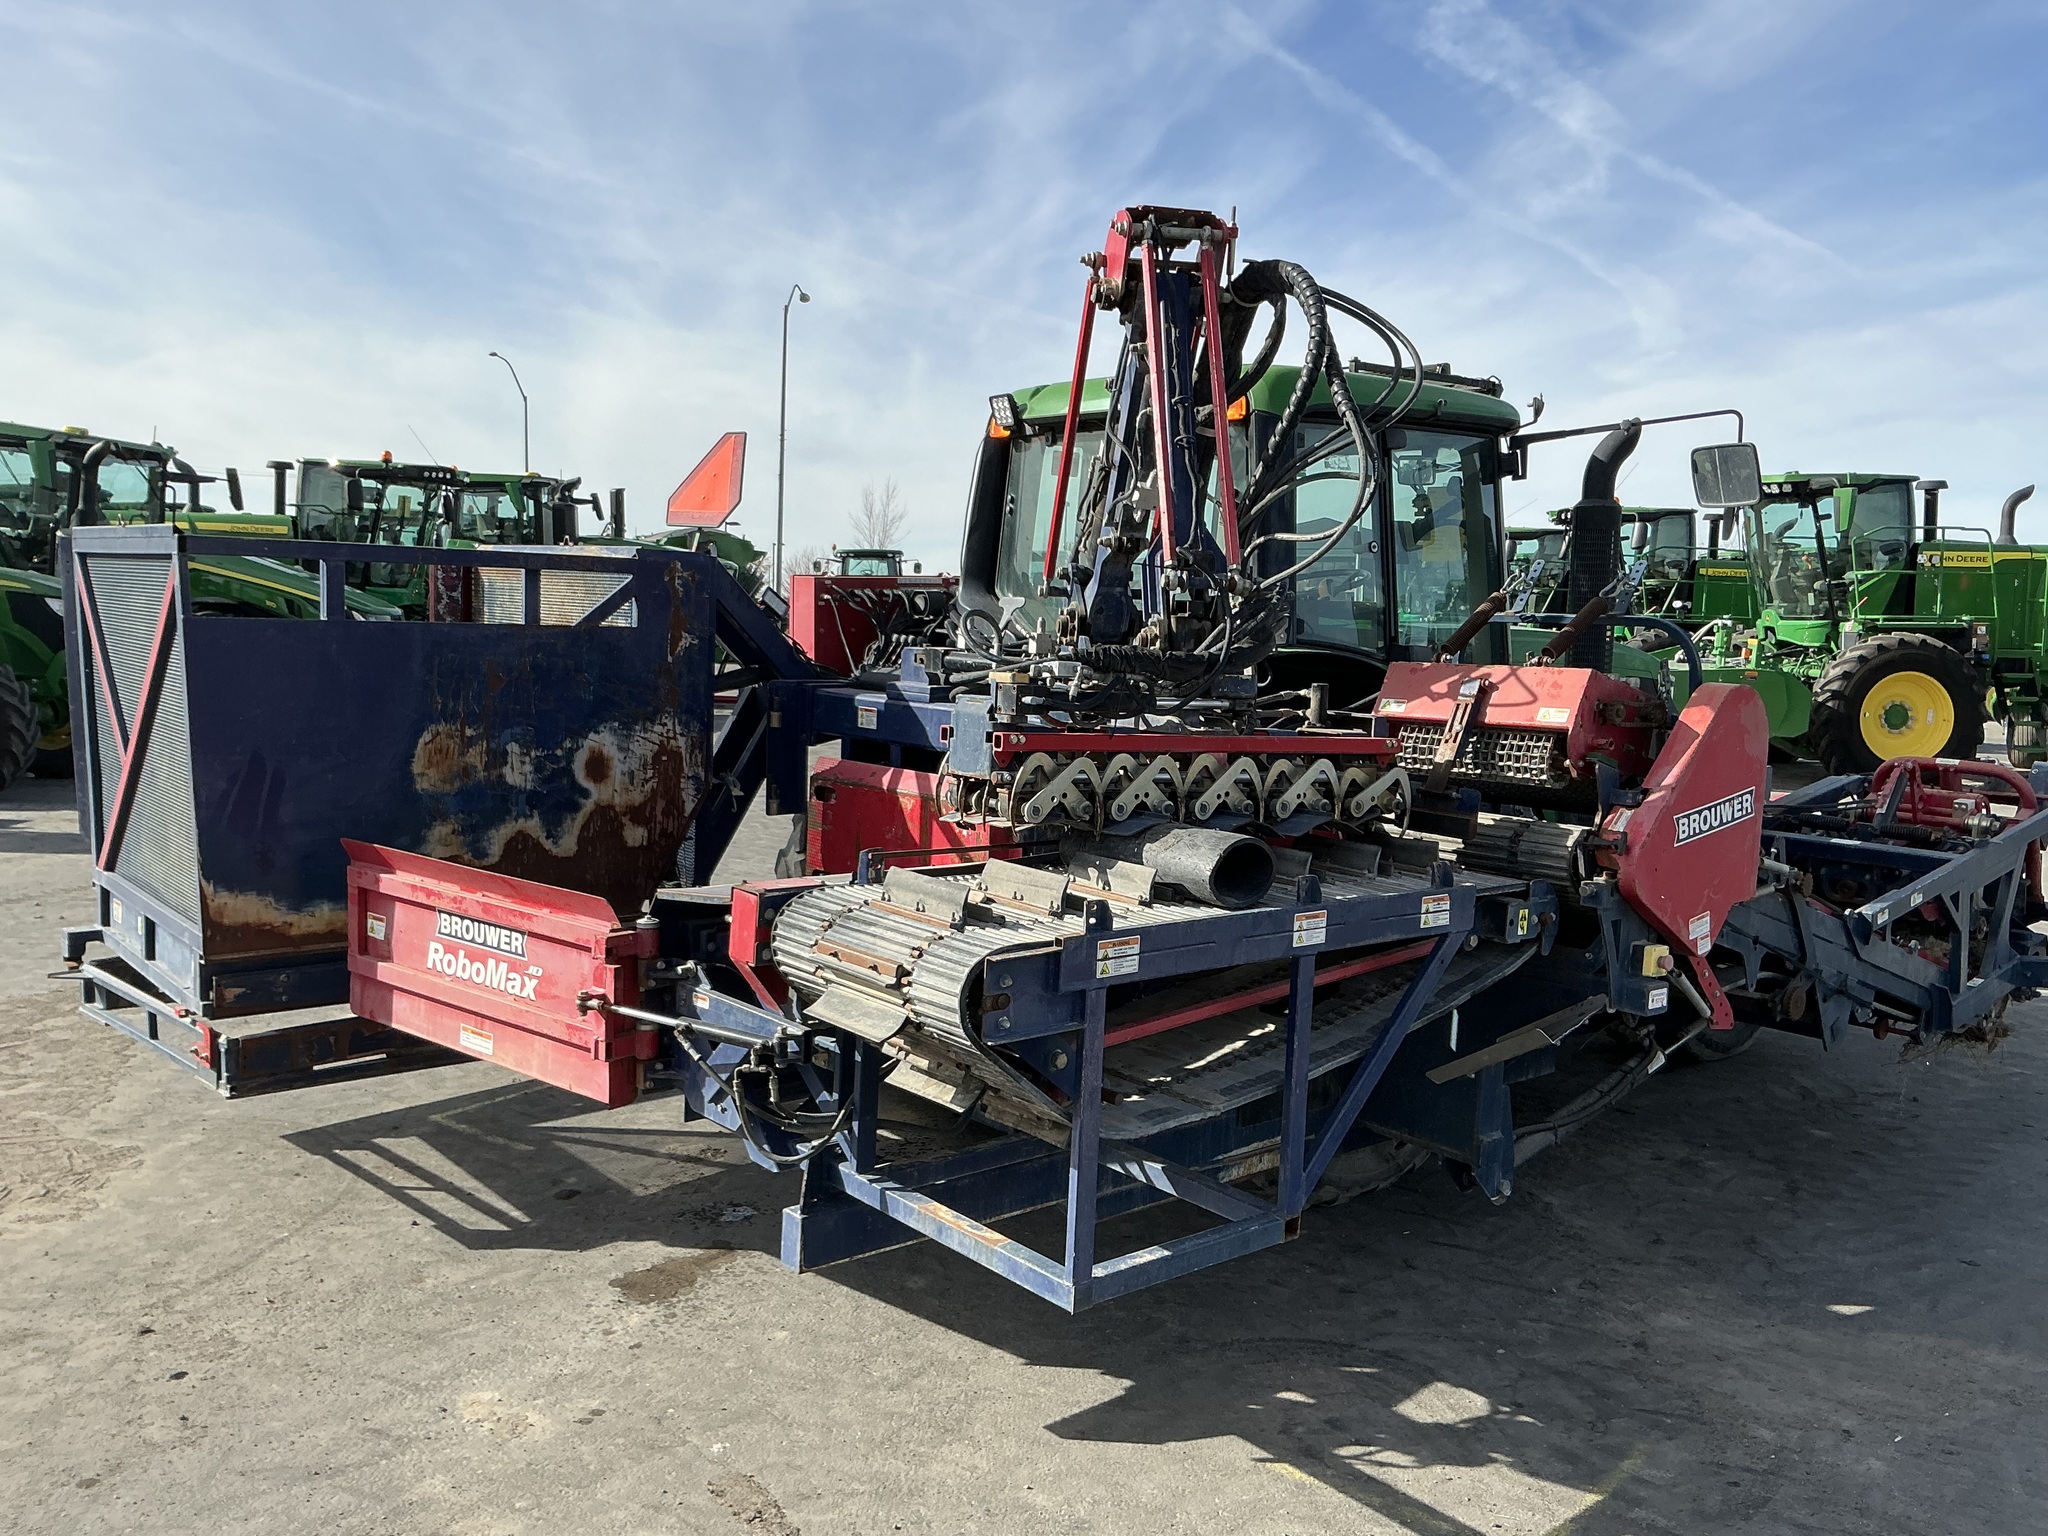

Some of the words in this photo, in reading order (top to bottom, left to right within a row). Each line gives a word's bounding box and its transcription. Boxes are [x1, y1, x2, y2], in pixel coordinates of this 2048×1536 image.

[250, 525, 275, 533] DEERE
[1678, 793, 1752, 840] BROUWER
[440, 912, 523, 954] BROUWER
[426, 940, 539, 1001] RoboMax
[524, 965, 543, 977] JD
